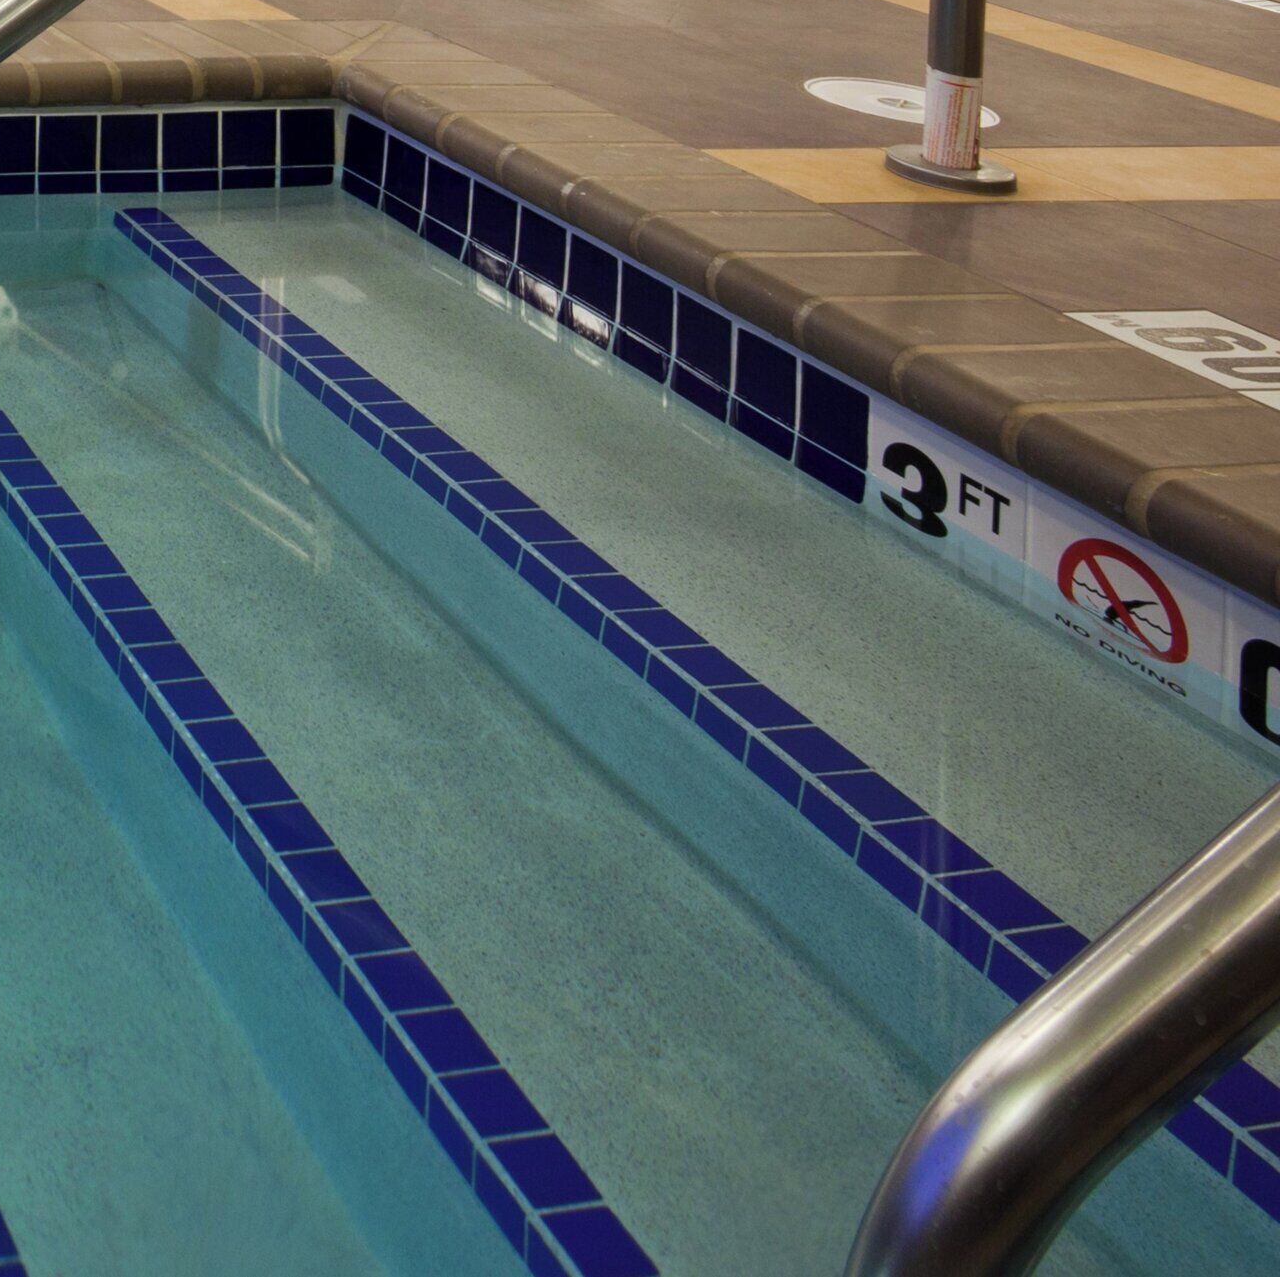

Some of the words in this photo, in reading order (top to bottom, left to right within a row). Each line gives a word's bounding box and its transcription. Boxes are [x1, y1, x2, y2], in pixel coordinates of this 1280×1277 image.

[881, 442, 948, 538] 3
[959, 473, 1010, 535] FT
[1055, 613, 1090, 638] NO
[1099, 639, 1187, 697] DIVING
